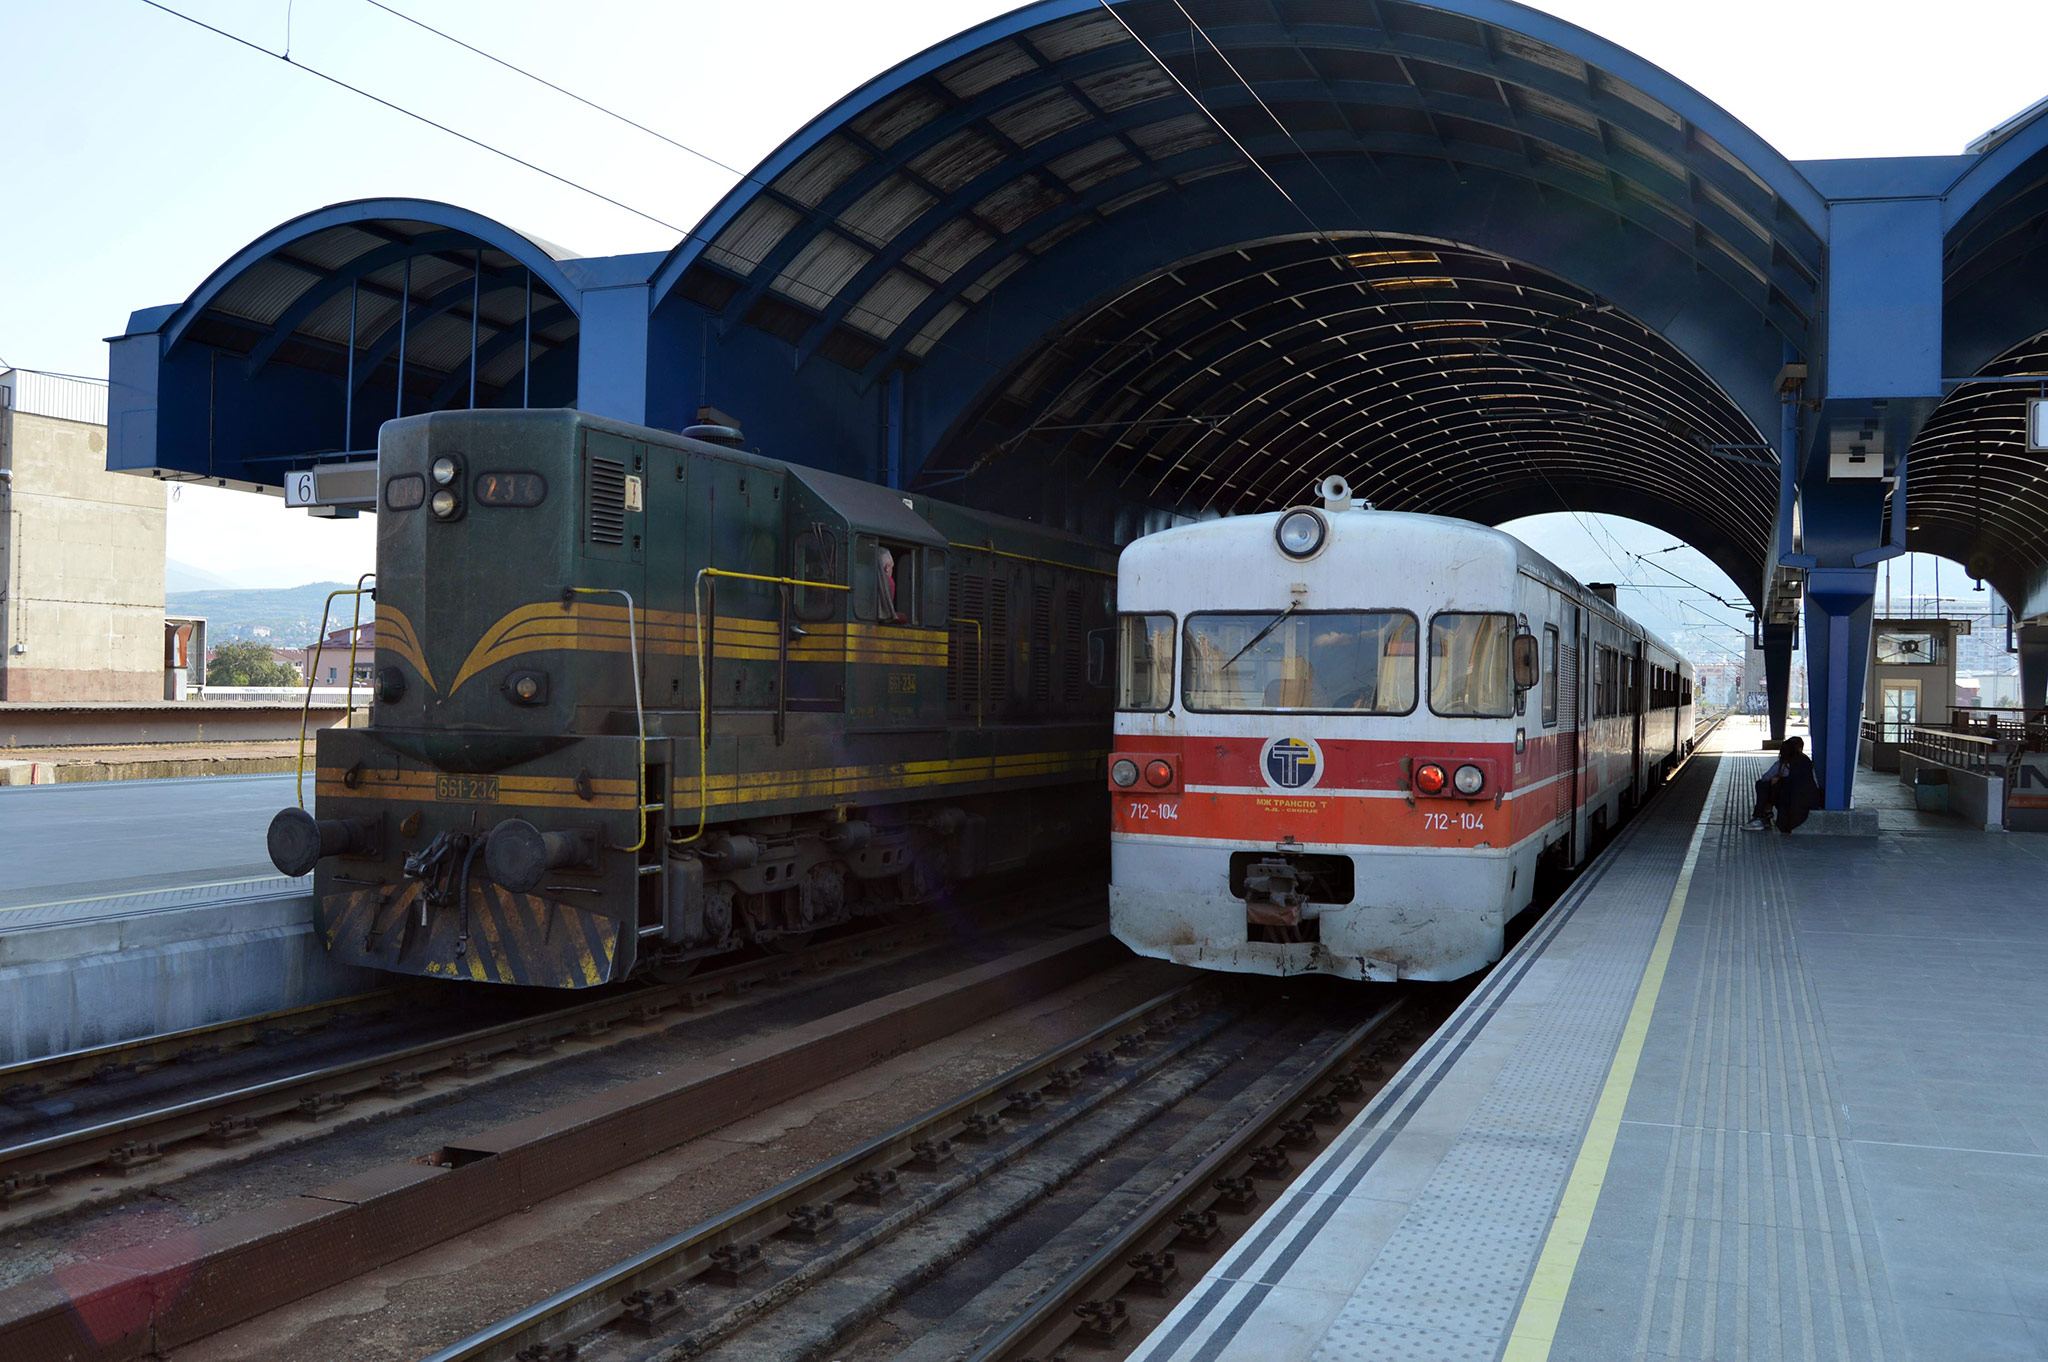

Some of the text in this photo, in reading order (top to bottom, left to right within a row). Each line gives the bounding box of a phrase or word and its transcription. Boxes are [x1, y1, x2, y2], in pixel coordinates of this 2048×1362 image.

[298, 474, 311, 502] 6
[440, 778, 496, 800] 661-234
[1256, 798, 1272, 806] МЖ
[1130, 803, 1178, 820] 712-104
[1424, 812, 1484, 830] 712-104
